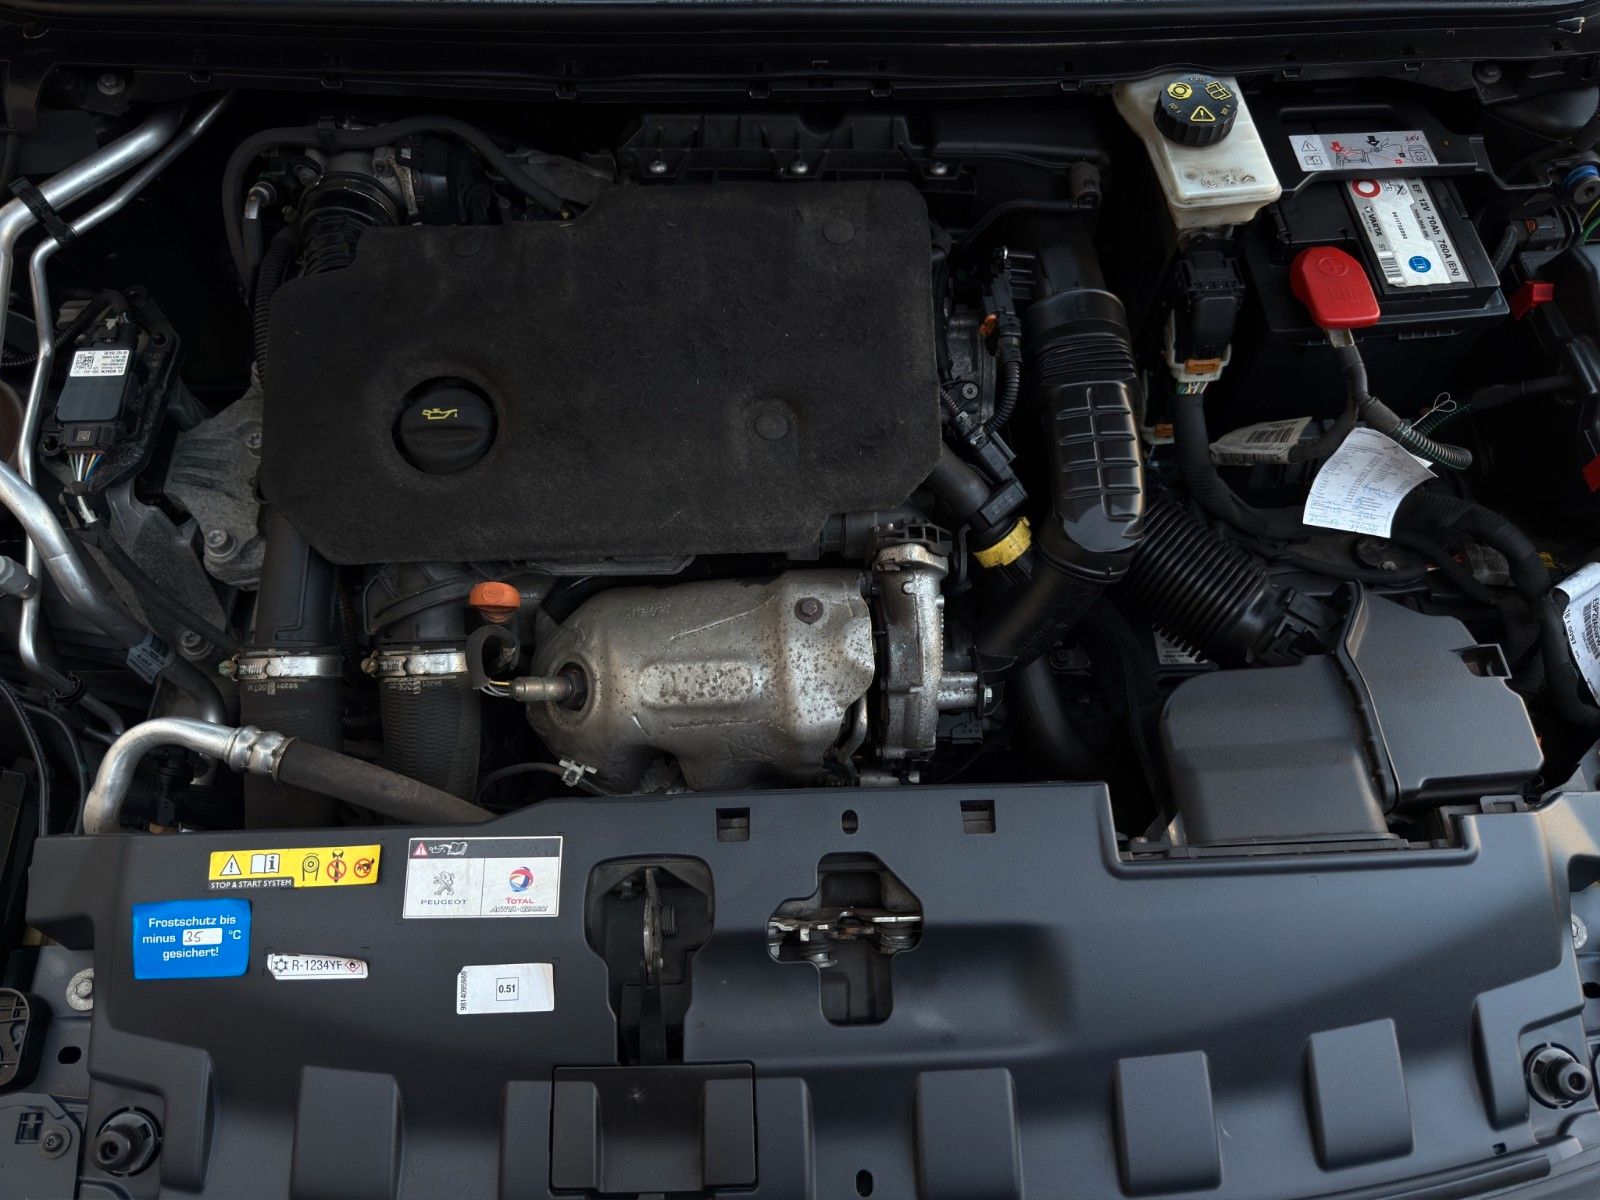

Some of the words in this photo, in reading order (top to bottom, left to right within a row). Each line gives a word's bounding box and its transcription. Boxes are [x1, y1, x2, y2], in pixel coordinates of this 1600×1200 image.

[1368, 213, 1383, 237] VARTA
[1418, 198, 1431, 212] 12V
[1426, 215, 1440, 235] 70Ah
[1438, 239, 1452, 259] 760A
[1446, 260, 1460, 276] (EN)
[239, 880, 262, 888] START
[263, 879, 292, 887] SYSTEM
[148, 916, 216, 928] Frostschutz
[220, 915, 236, 925] bis
[142, 933, 176, 944] minus
[228, 929, 242, 940] °C
[162, 947, 219, 961] gesichert!
[292, 959, 343, 971] R-1234YF
[498, 984, 516, 993] 0.51
